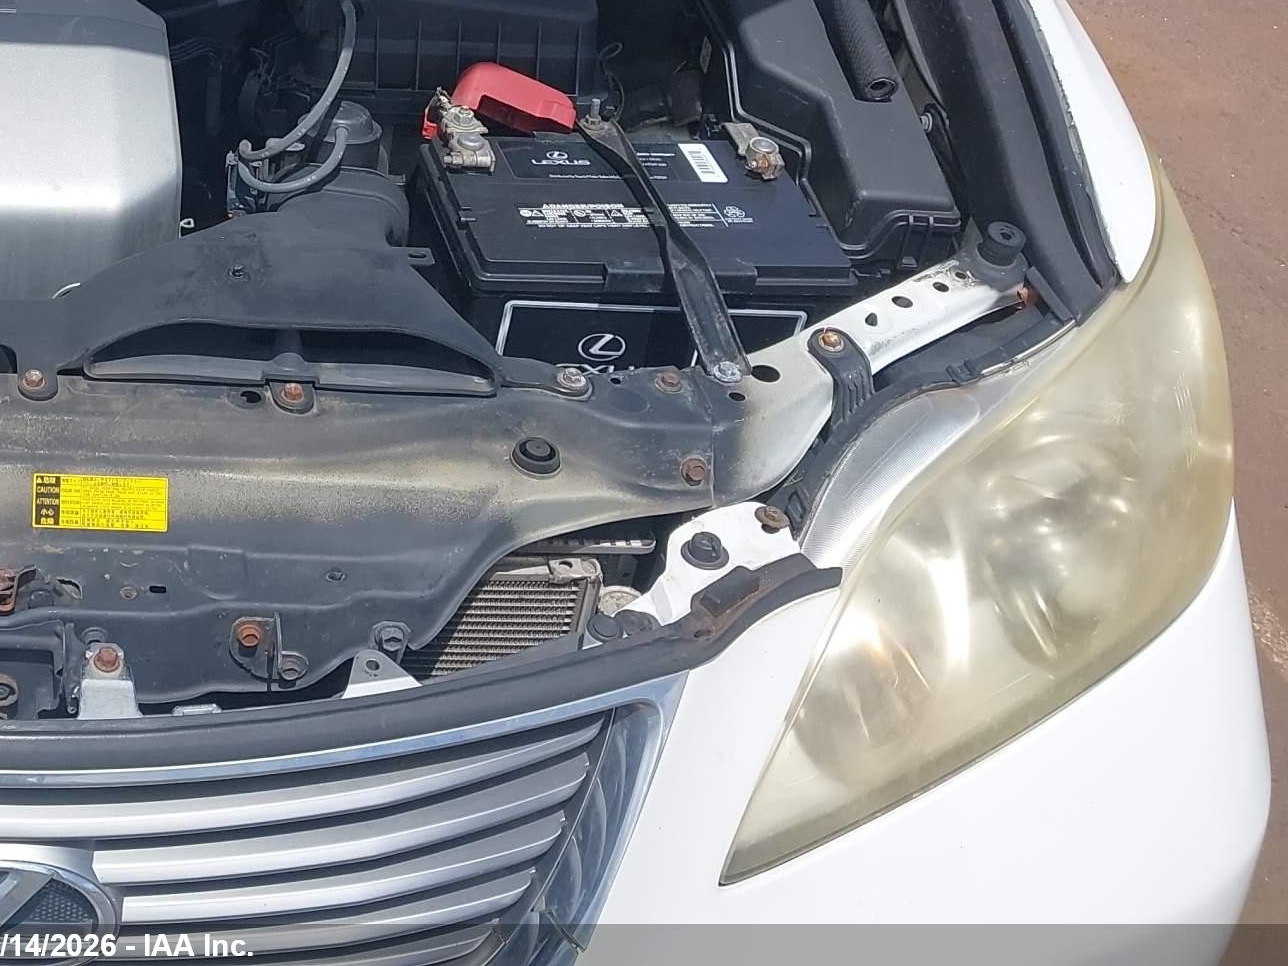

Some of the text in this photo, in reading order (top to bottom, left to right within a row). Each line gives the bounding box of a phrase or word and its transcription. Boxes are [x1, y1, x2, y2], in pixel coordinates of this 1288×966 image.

[531, 158, 591, 166] LEXUS
[36, 486, 59, 494] CAUTION
[36, 497, 59, 505] ATTENTION
